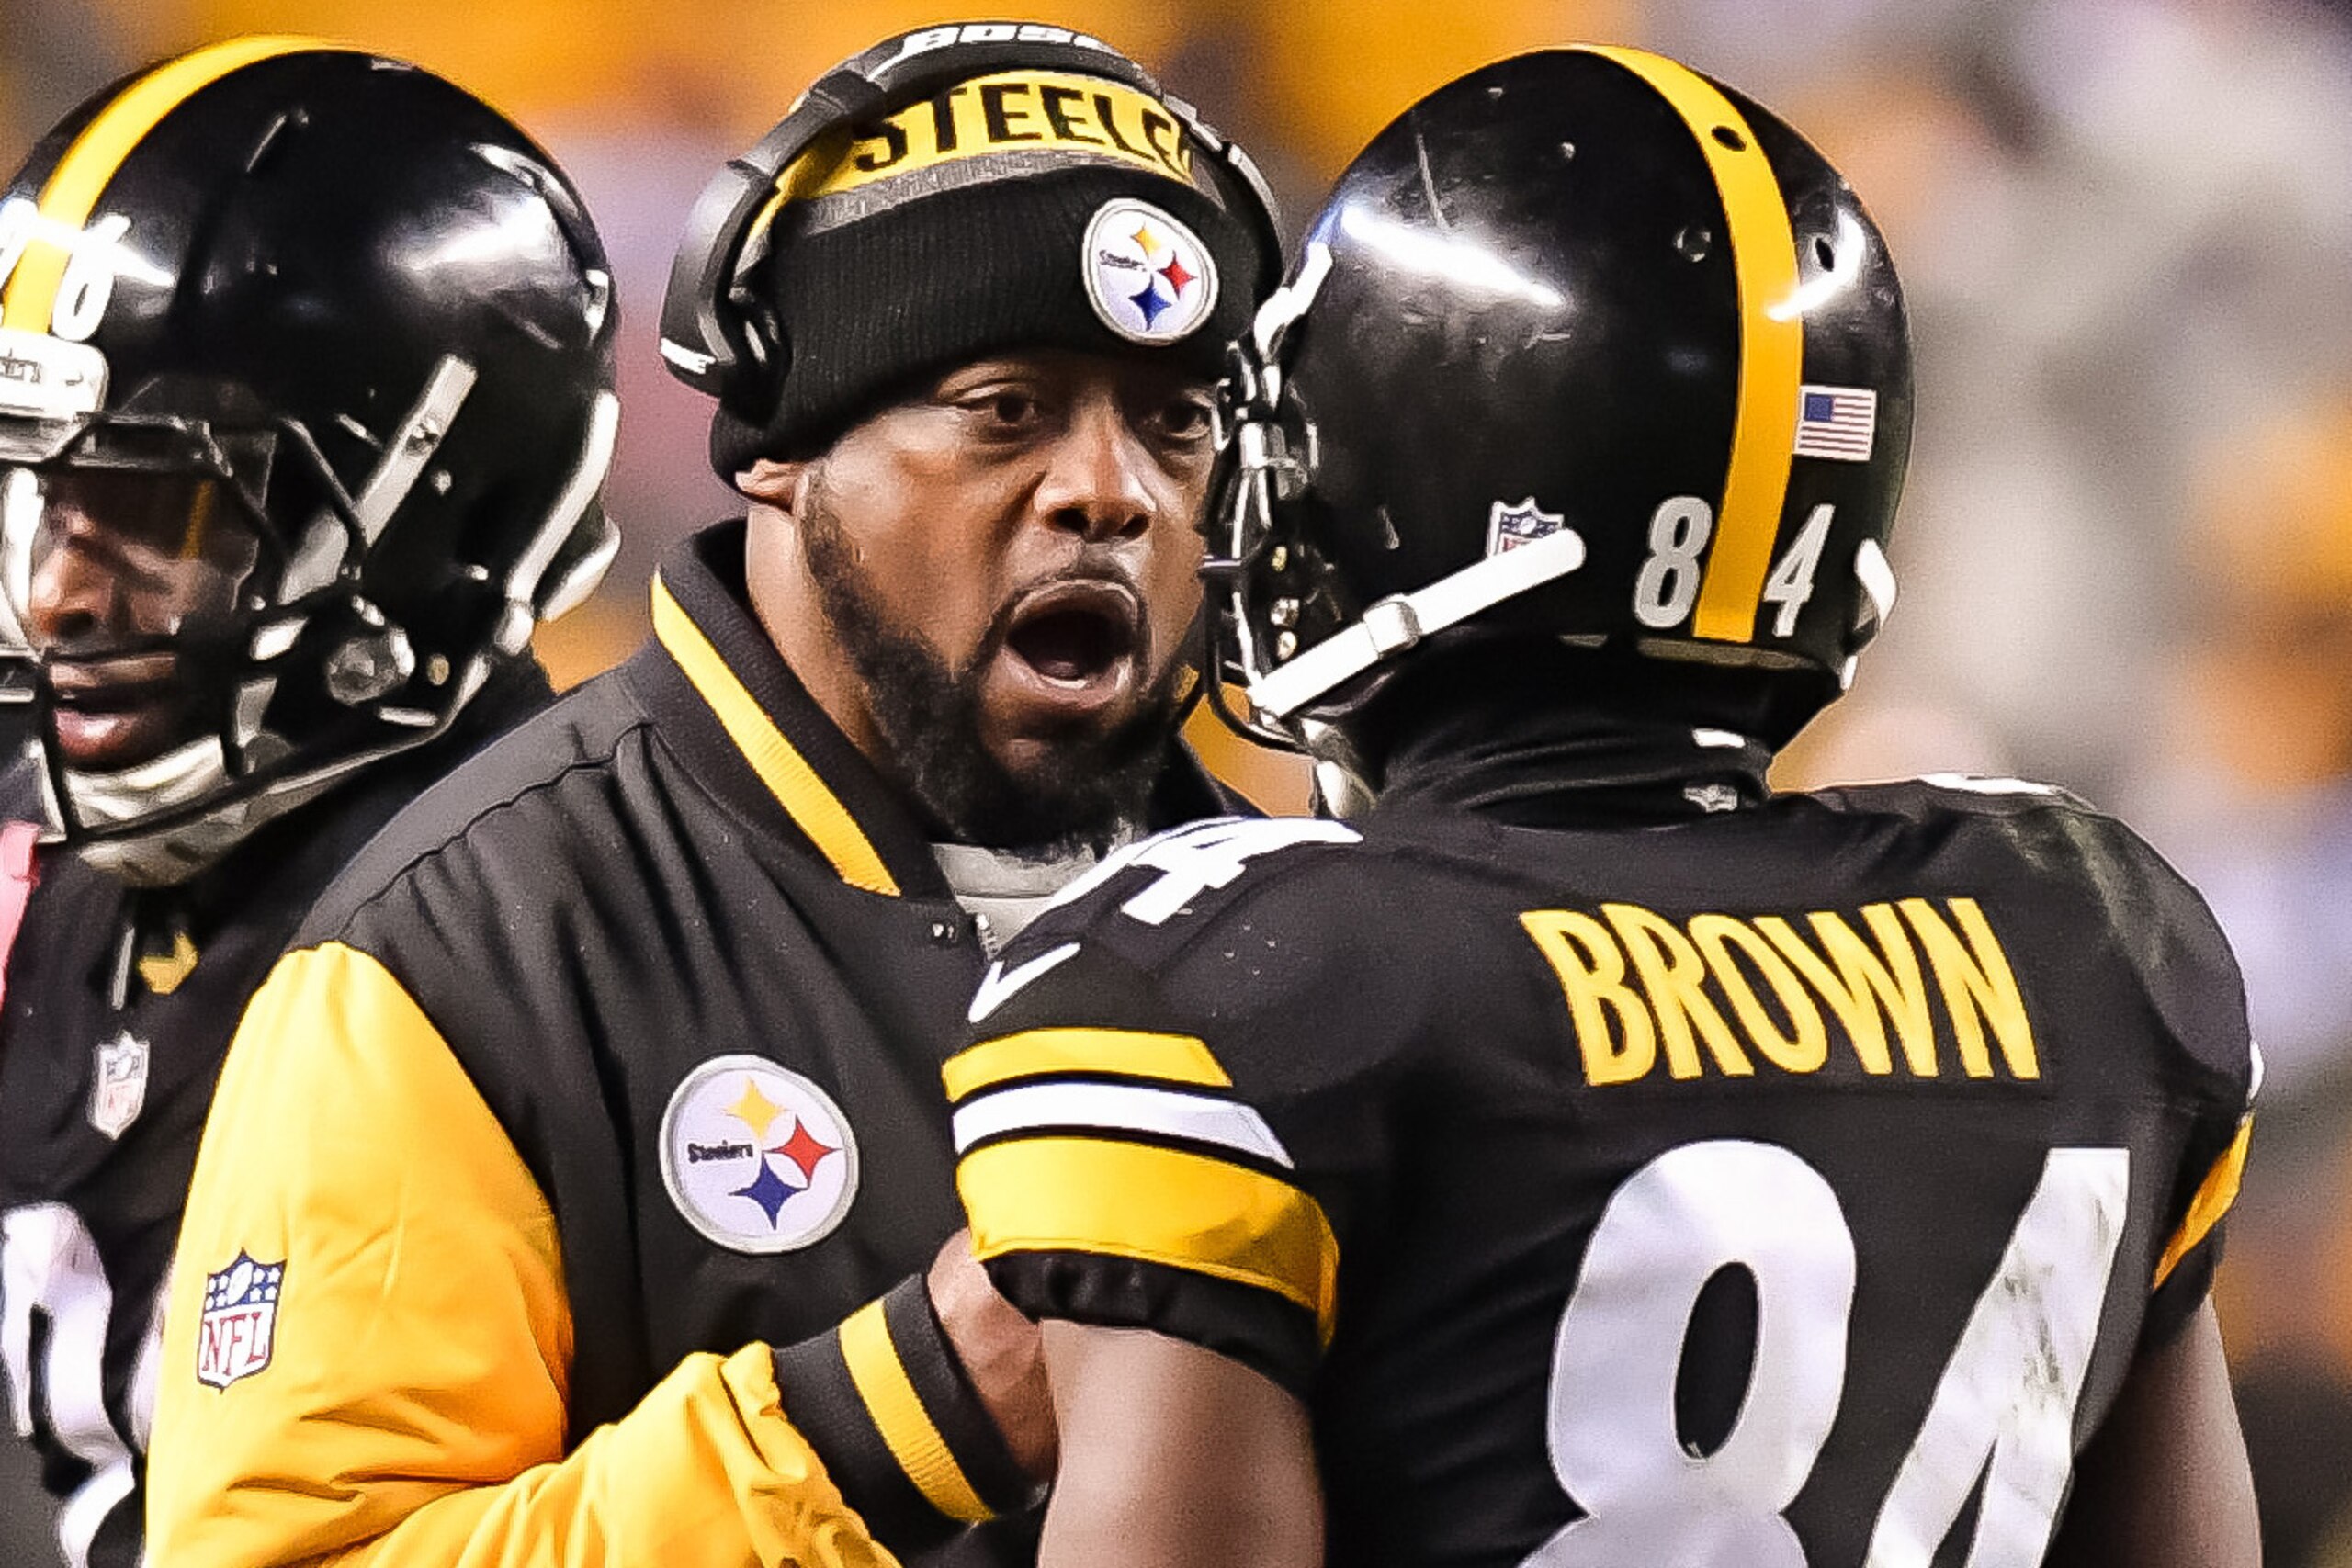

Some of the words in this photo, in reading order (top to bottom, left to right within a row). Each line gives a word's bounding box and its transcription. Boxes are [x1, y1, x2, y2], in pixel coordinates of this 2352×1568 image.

[1634, 495, 1836, 637] 84
[1519, 897, 2041, 1086] BROWN
[201, 1312, 266, 1376] NFL
[1518, 1139, 2130, 1568] 84
